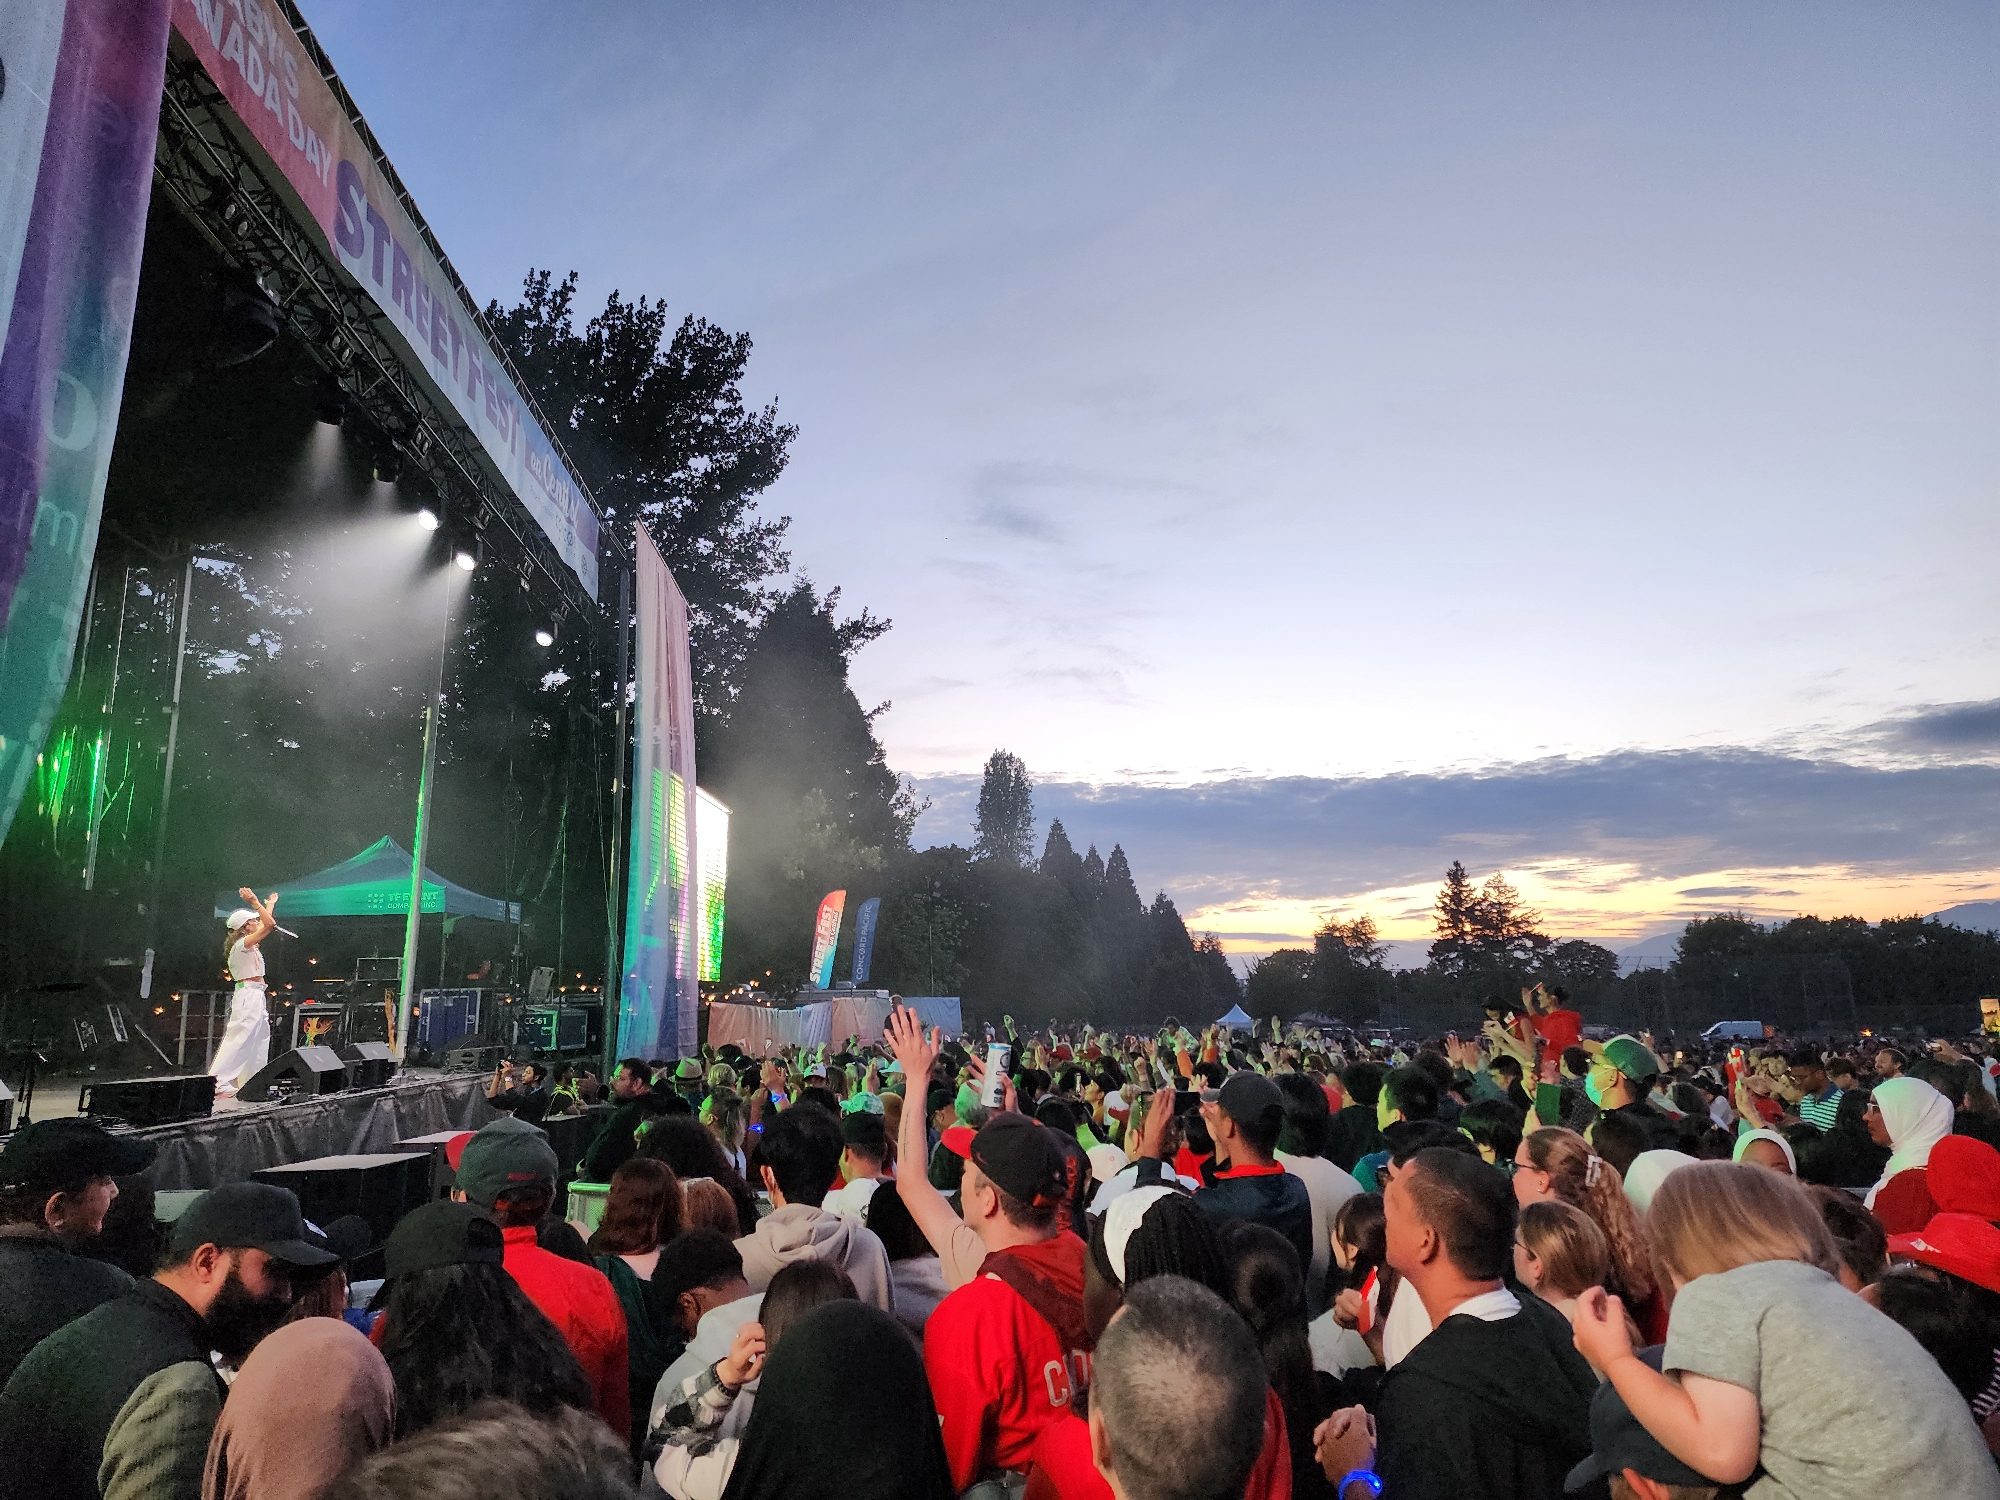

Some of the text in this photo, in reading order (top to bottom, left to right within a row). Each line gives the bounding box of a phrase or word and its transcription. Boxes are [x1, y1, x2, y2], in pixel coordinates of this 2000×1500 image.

[191, 0, 332, 188] NADA DAY
[862, 904, 872, 935] PACIFIC
[524, 1017, 547, 1025] CC-61
